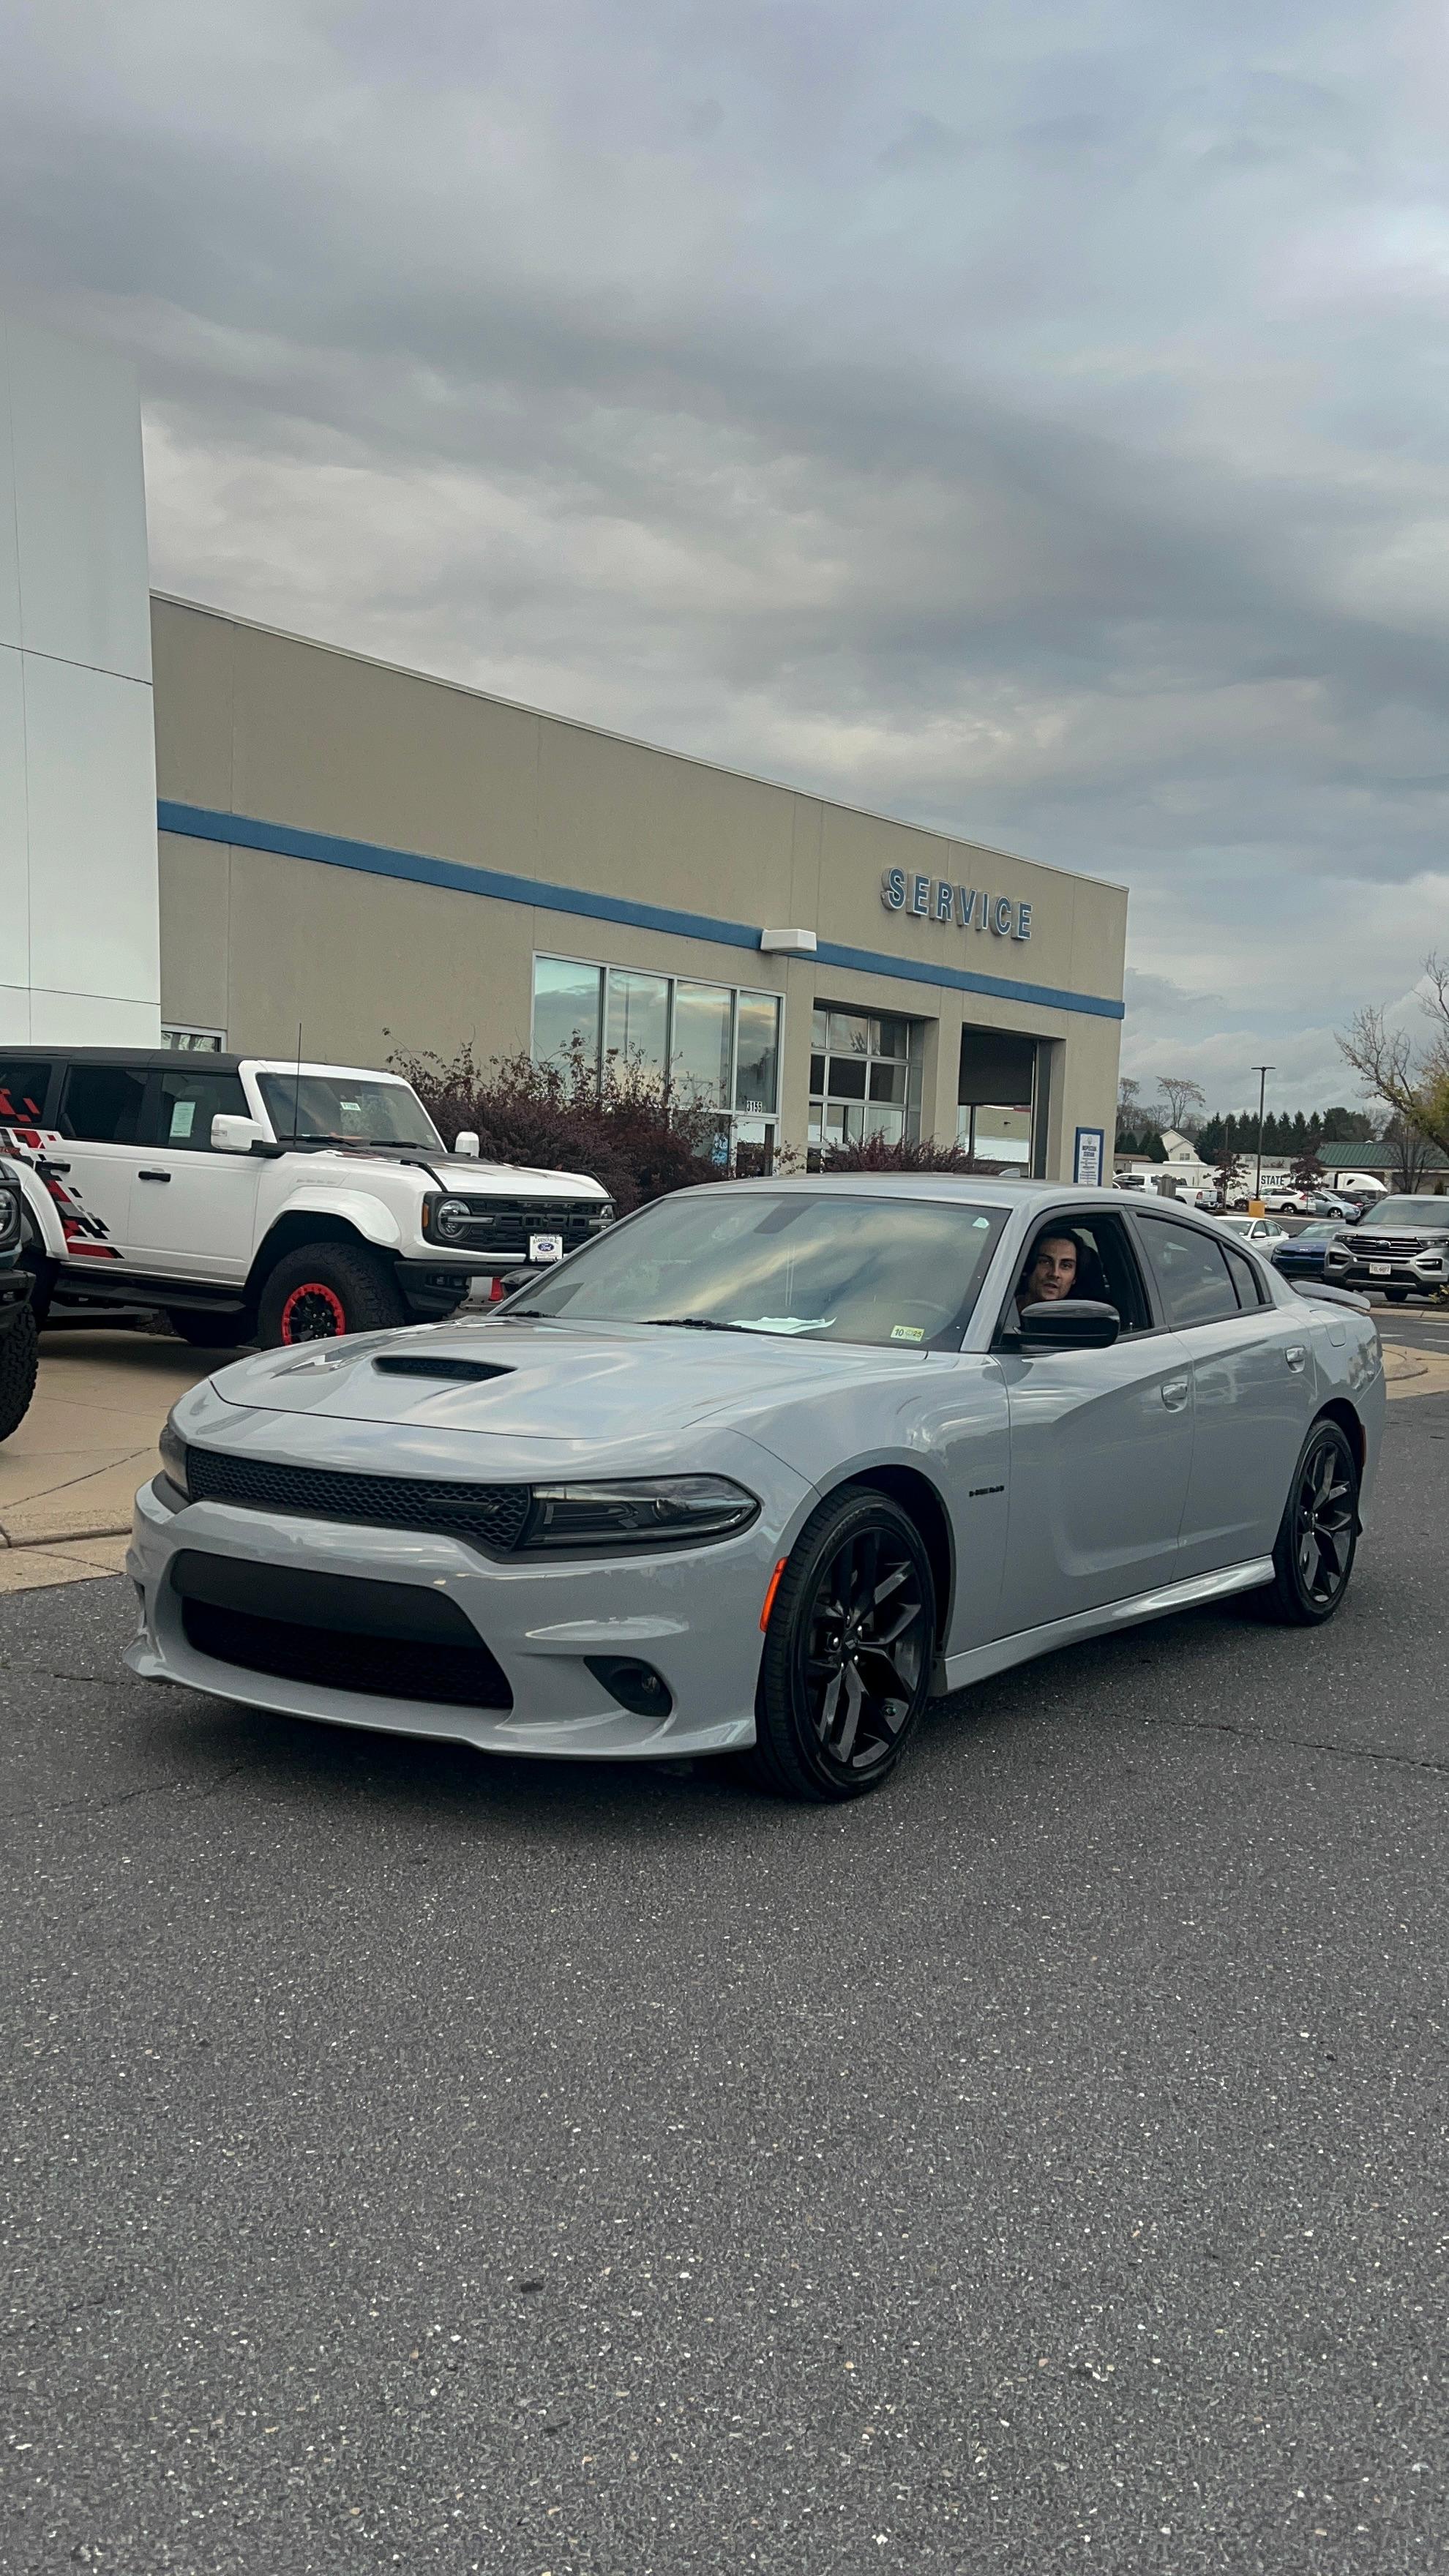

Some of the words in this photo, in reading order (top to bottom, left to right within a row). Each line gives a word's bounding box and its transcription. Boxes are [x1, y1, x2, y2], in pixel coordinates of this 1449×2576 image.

[880, 866, 1033, 940] SERVICE
[747, 1101, 762, 1112] 3155
[1260, 1175, 1285, 1186] STATE
[895, 1328, 904, 1336] 10
